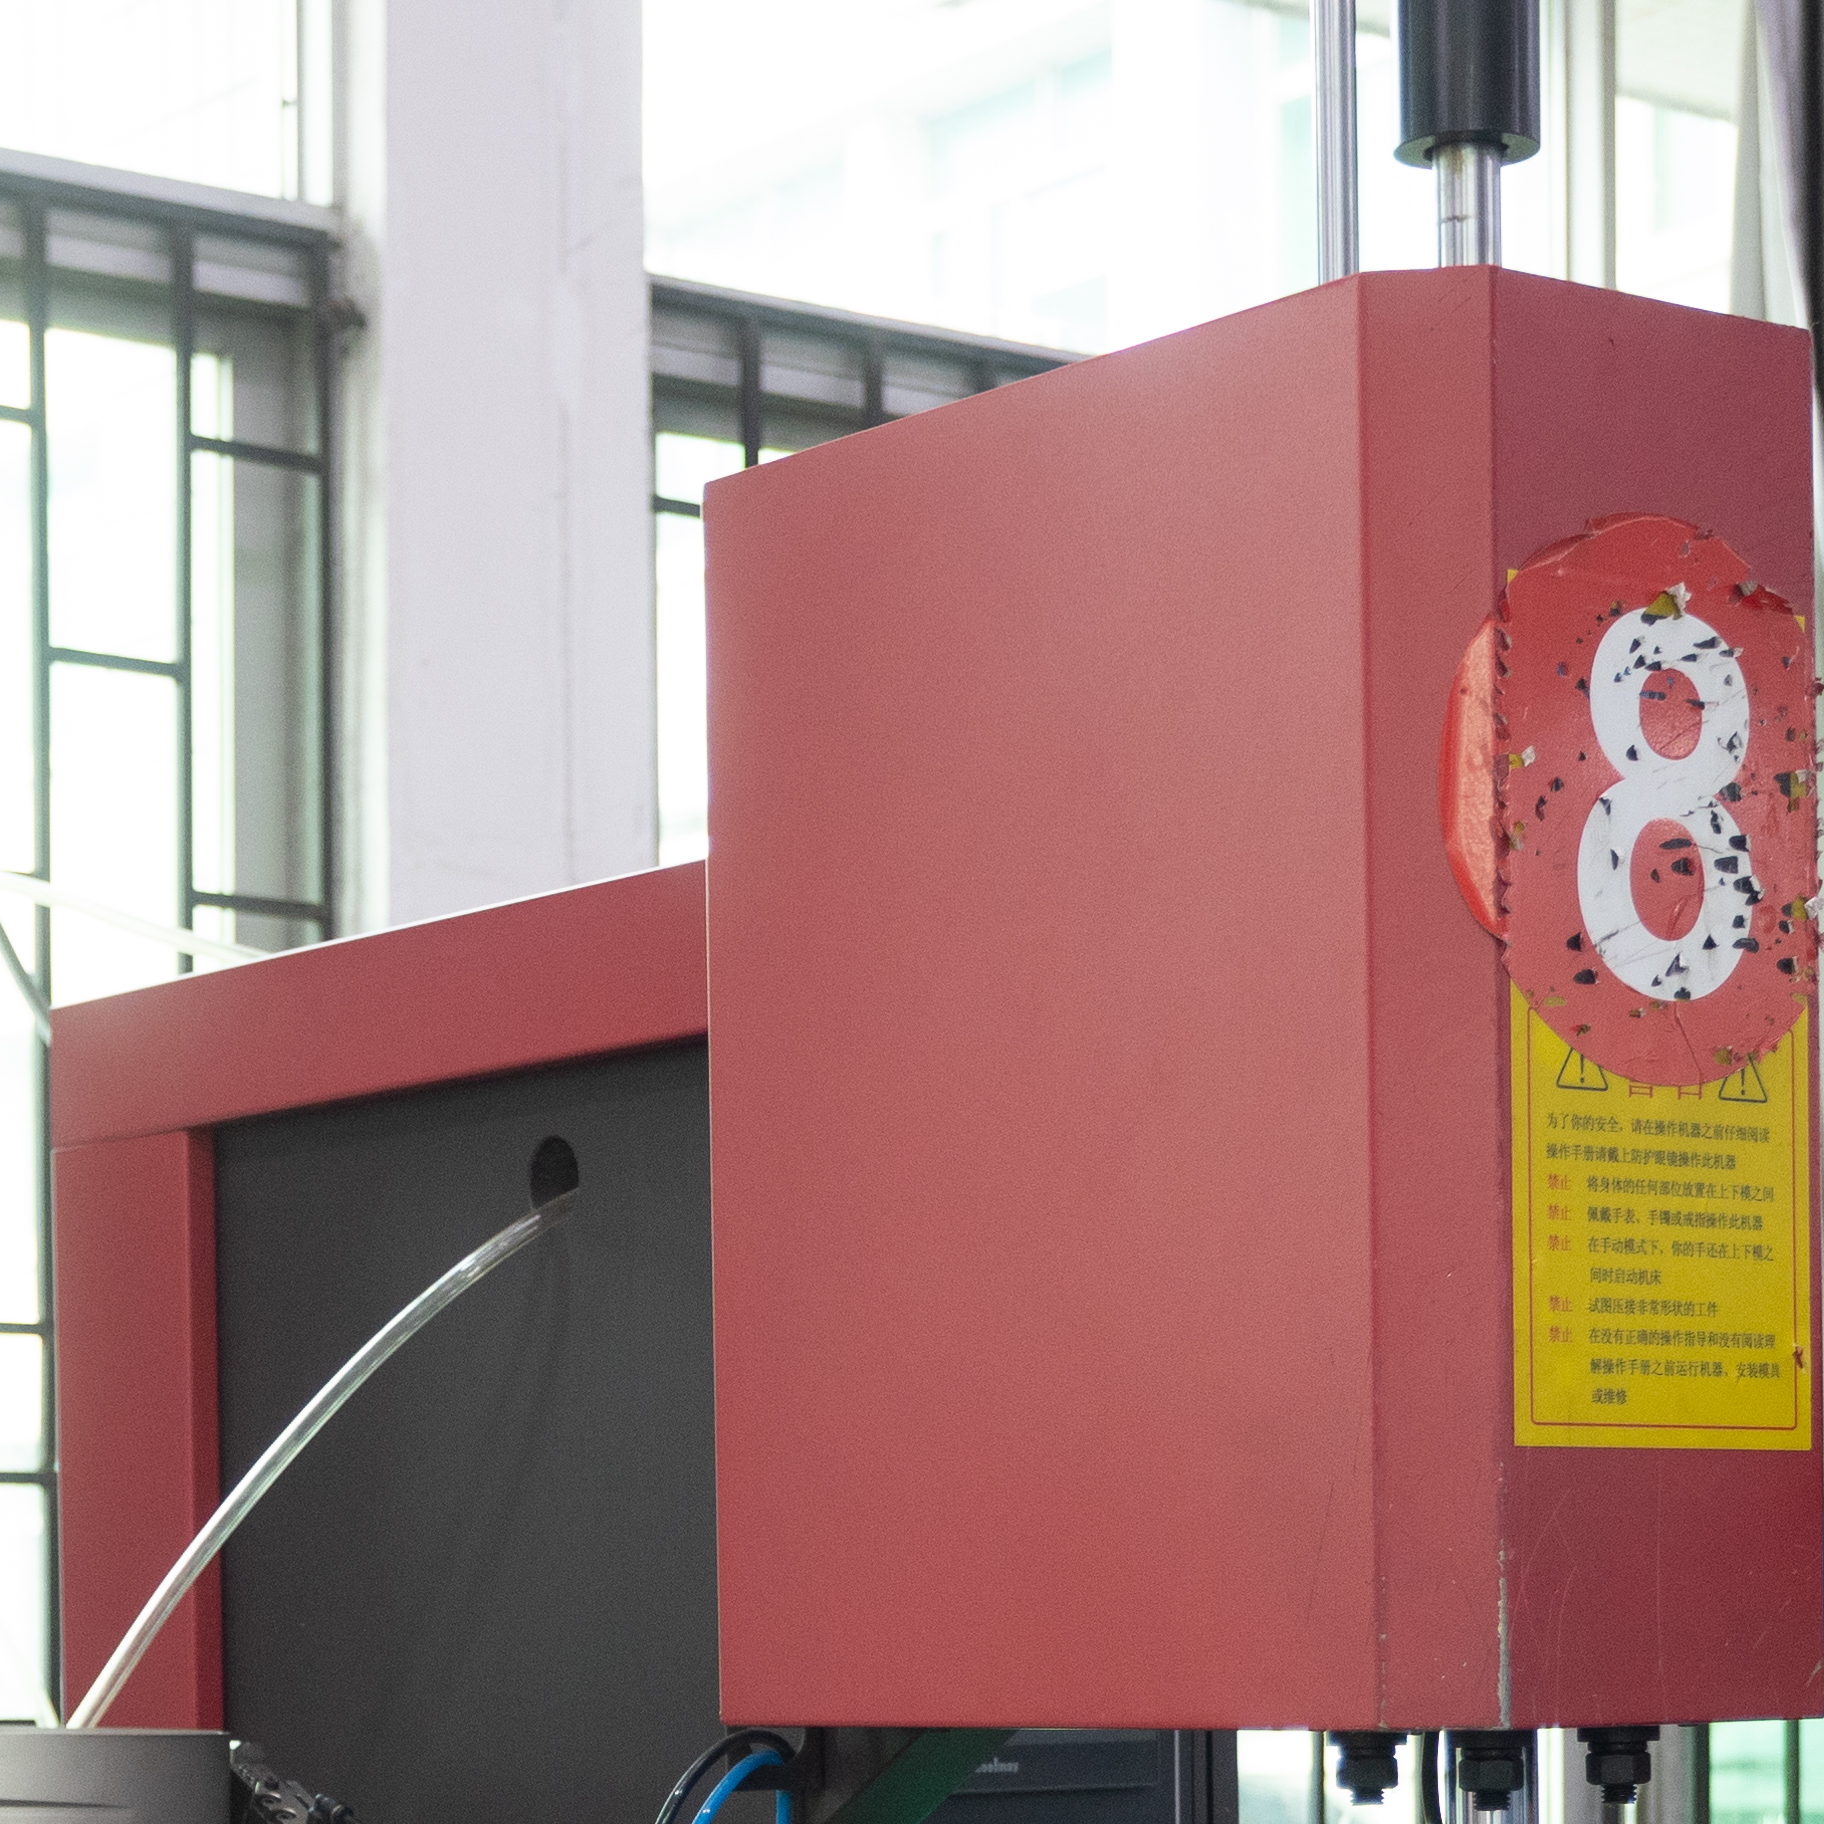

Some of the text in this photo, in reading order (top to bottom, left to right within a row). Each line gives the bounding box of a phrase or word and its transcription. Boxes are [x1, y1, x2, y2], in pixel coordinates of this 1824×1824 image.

[1576, 606, 1753, 1002] 8
[1548, 1173, 1571, 1191] 禁止
[1548, 1204, 1571, 1221] 禁止
[1548, 1234, 1571, 1252] 禁止
[1549, 1295, 1573, 1313] 禁止
[1549, 1325, 1573, 1343] 禁止
